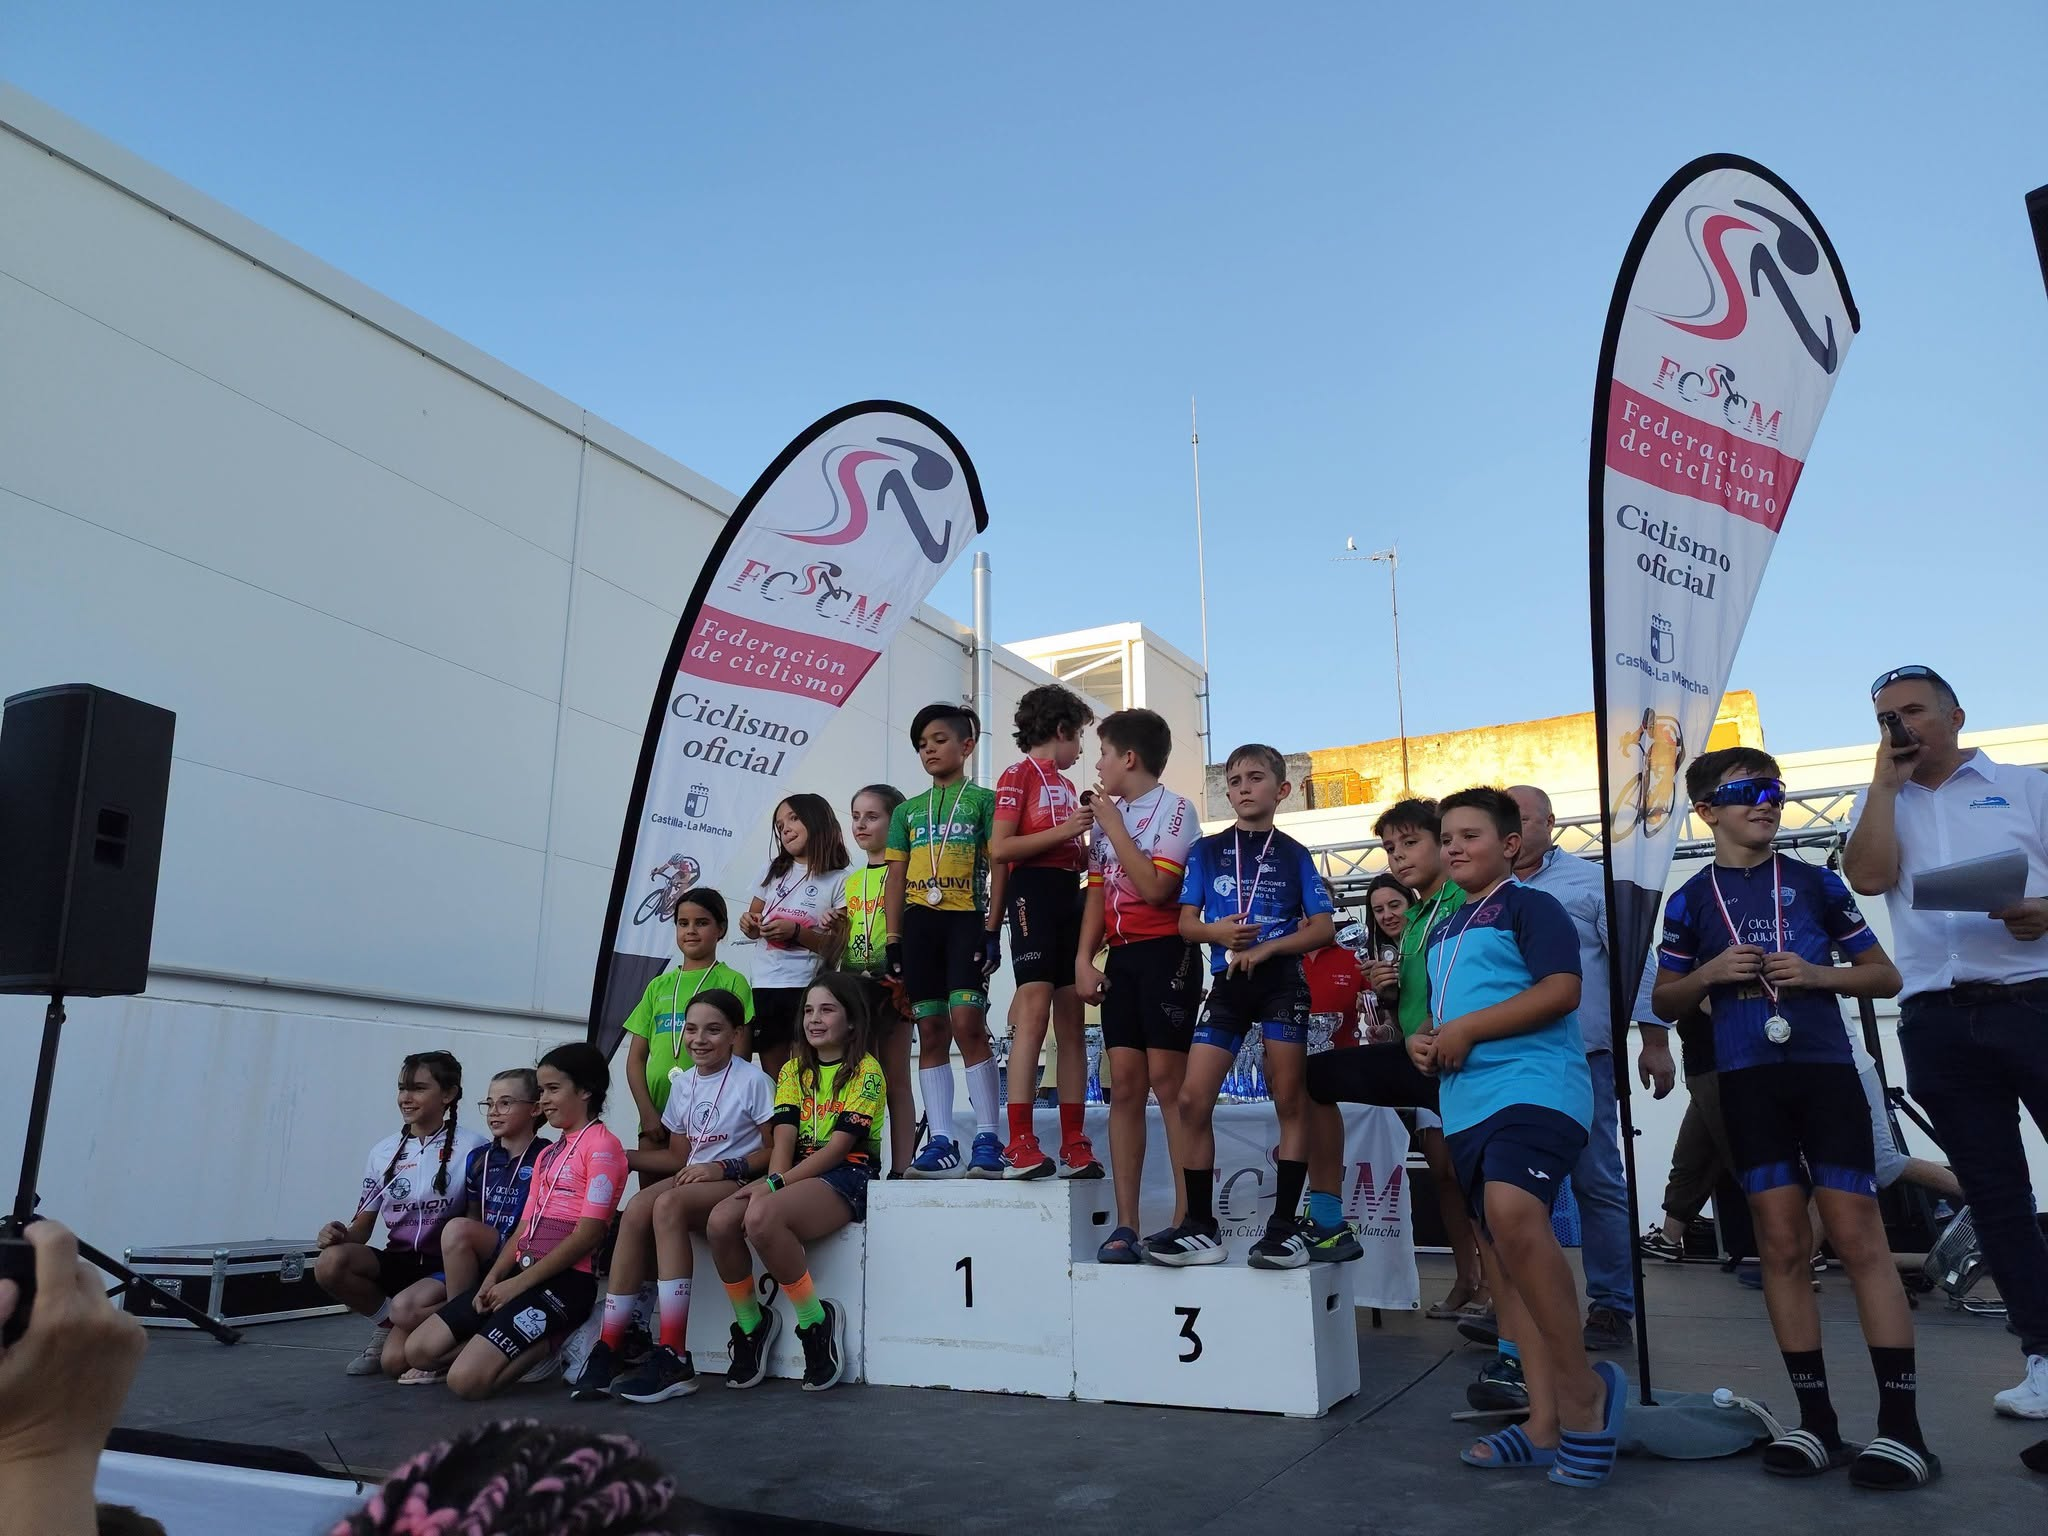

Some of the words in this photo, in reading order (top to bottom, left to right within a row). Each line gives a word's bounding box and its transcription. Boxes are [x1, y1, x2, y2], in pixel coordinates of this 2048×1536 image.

[1621, 399, 1776, 486] Federación
[1619, 429, 1652, 459] de
[1659, 452, 1777, 515] ciclismo
[1616, 504, 1731, 572] Ciclismo
[1636, 552, 1715, 600] oficial
[690, 643, 721, 669] de
[729, 652, 845, 698] ciclismo
[697, 618, 847, 676] Federación
[1671, 669, 1709, 695] Mancha
[671, 692, 809, 747] Ciclismo
[683, 735, 785, 777] oficial
[698, 823, 733, 838] Mancha
[955, 1256, 974, 1308] 1
[1174, 1306, 1203, 1363] 3
